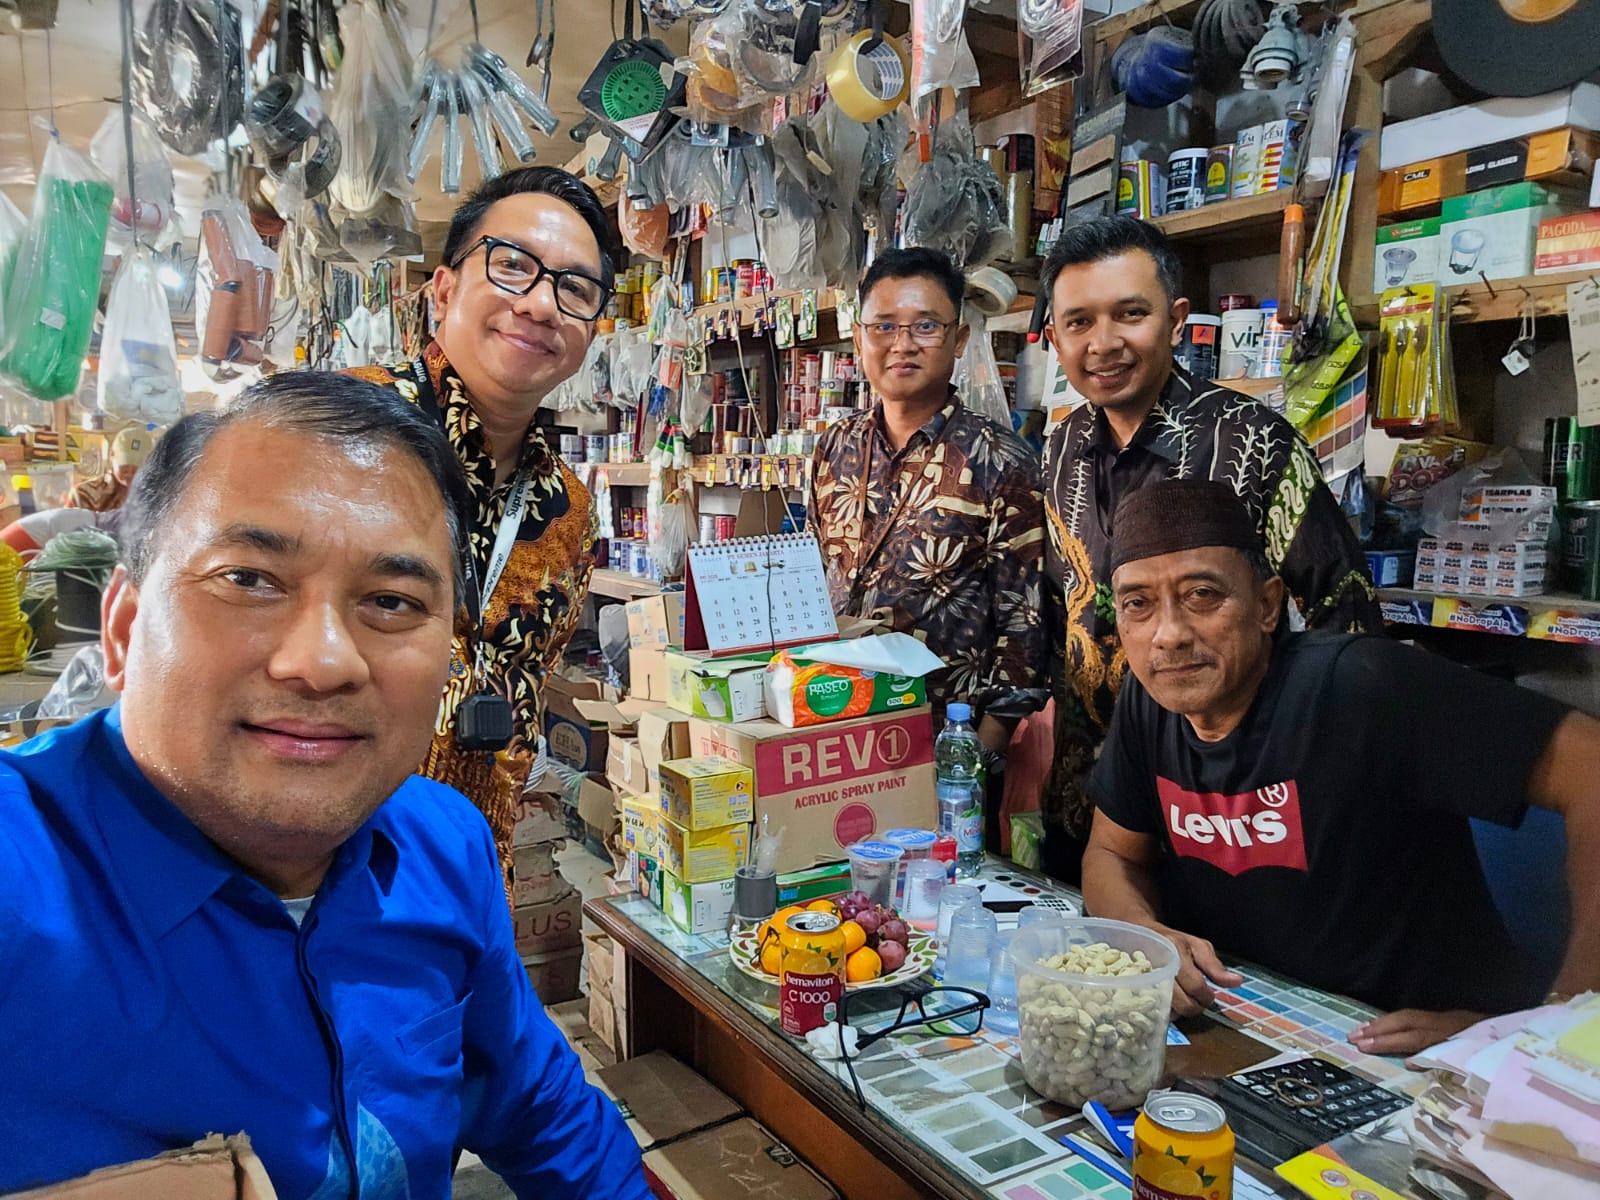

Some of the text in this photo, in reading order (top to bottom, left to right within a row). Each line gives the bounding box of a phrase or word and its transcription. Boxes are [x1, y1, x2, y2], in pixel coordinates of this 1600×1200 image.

[1487, 155, 1519, 168] GLASSES
[1541, 221, 1586, 238] PAGODA
[506, 479, 528, 519] Suprem
[1485, 489, 1532, 497] ISARPLAS
[1449, 613, 1511, 630] #NoDropAja
[808, 679, 850, 697] PASEO
[794, 775, 908, 810] ACRYLIC SPRAY PAINT
[1170, 803, 1288, 848] Levi's
[785, 972, 834, 988] hemaviton
